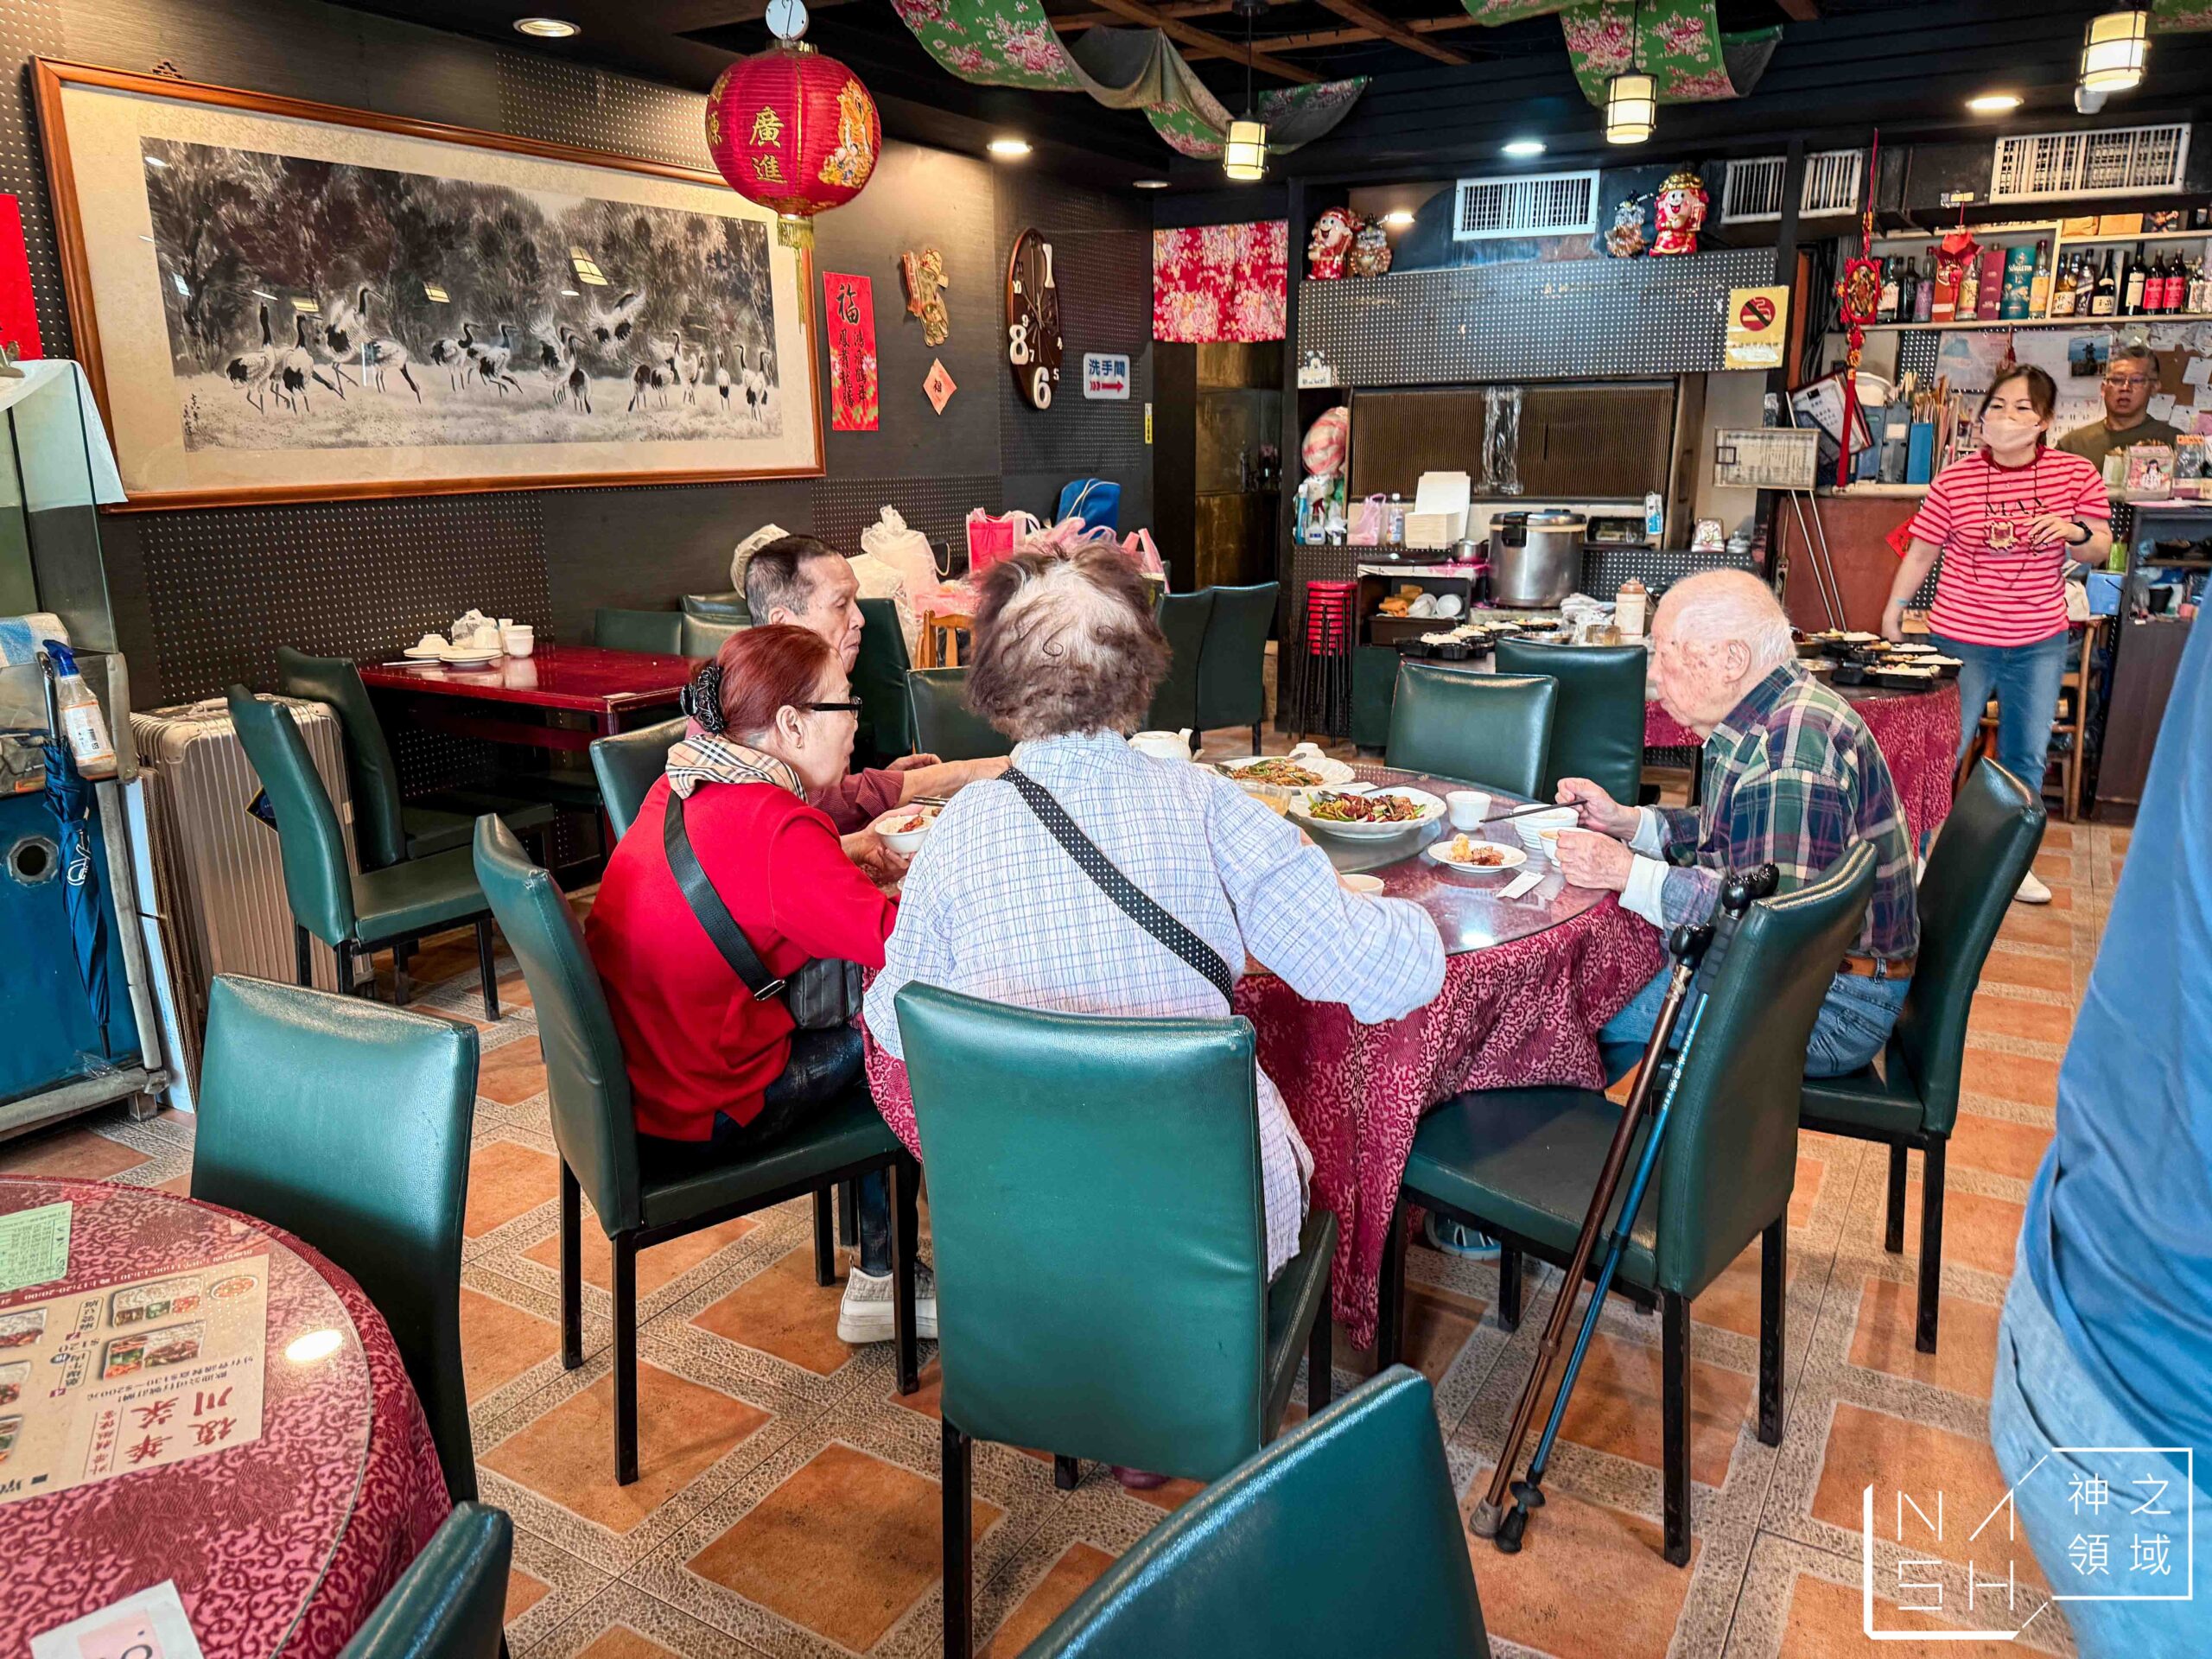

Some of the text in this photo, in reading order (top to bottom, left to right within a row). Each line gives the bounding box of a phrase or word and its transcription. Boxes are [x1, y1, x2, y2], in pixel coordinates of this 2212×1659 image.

[749, 106, 788, 183] 廣進
[1042, 243, 1055, 288] 1
[836, 283, 860, 324] 福
[1009, 324, 1029, 365] 8
[1033, 366, 1052, 410] 6
[1088, 358, 1127, 378] 洗手間
